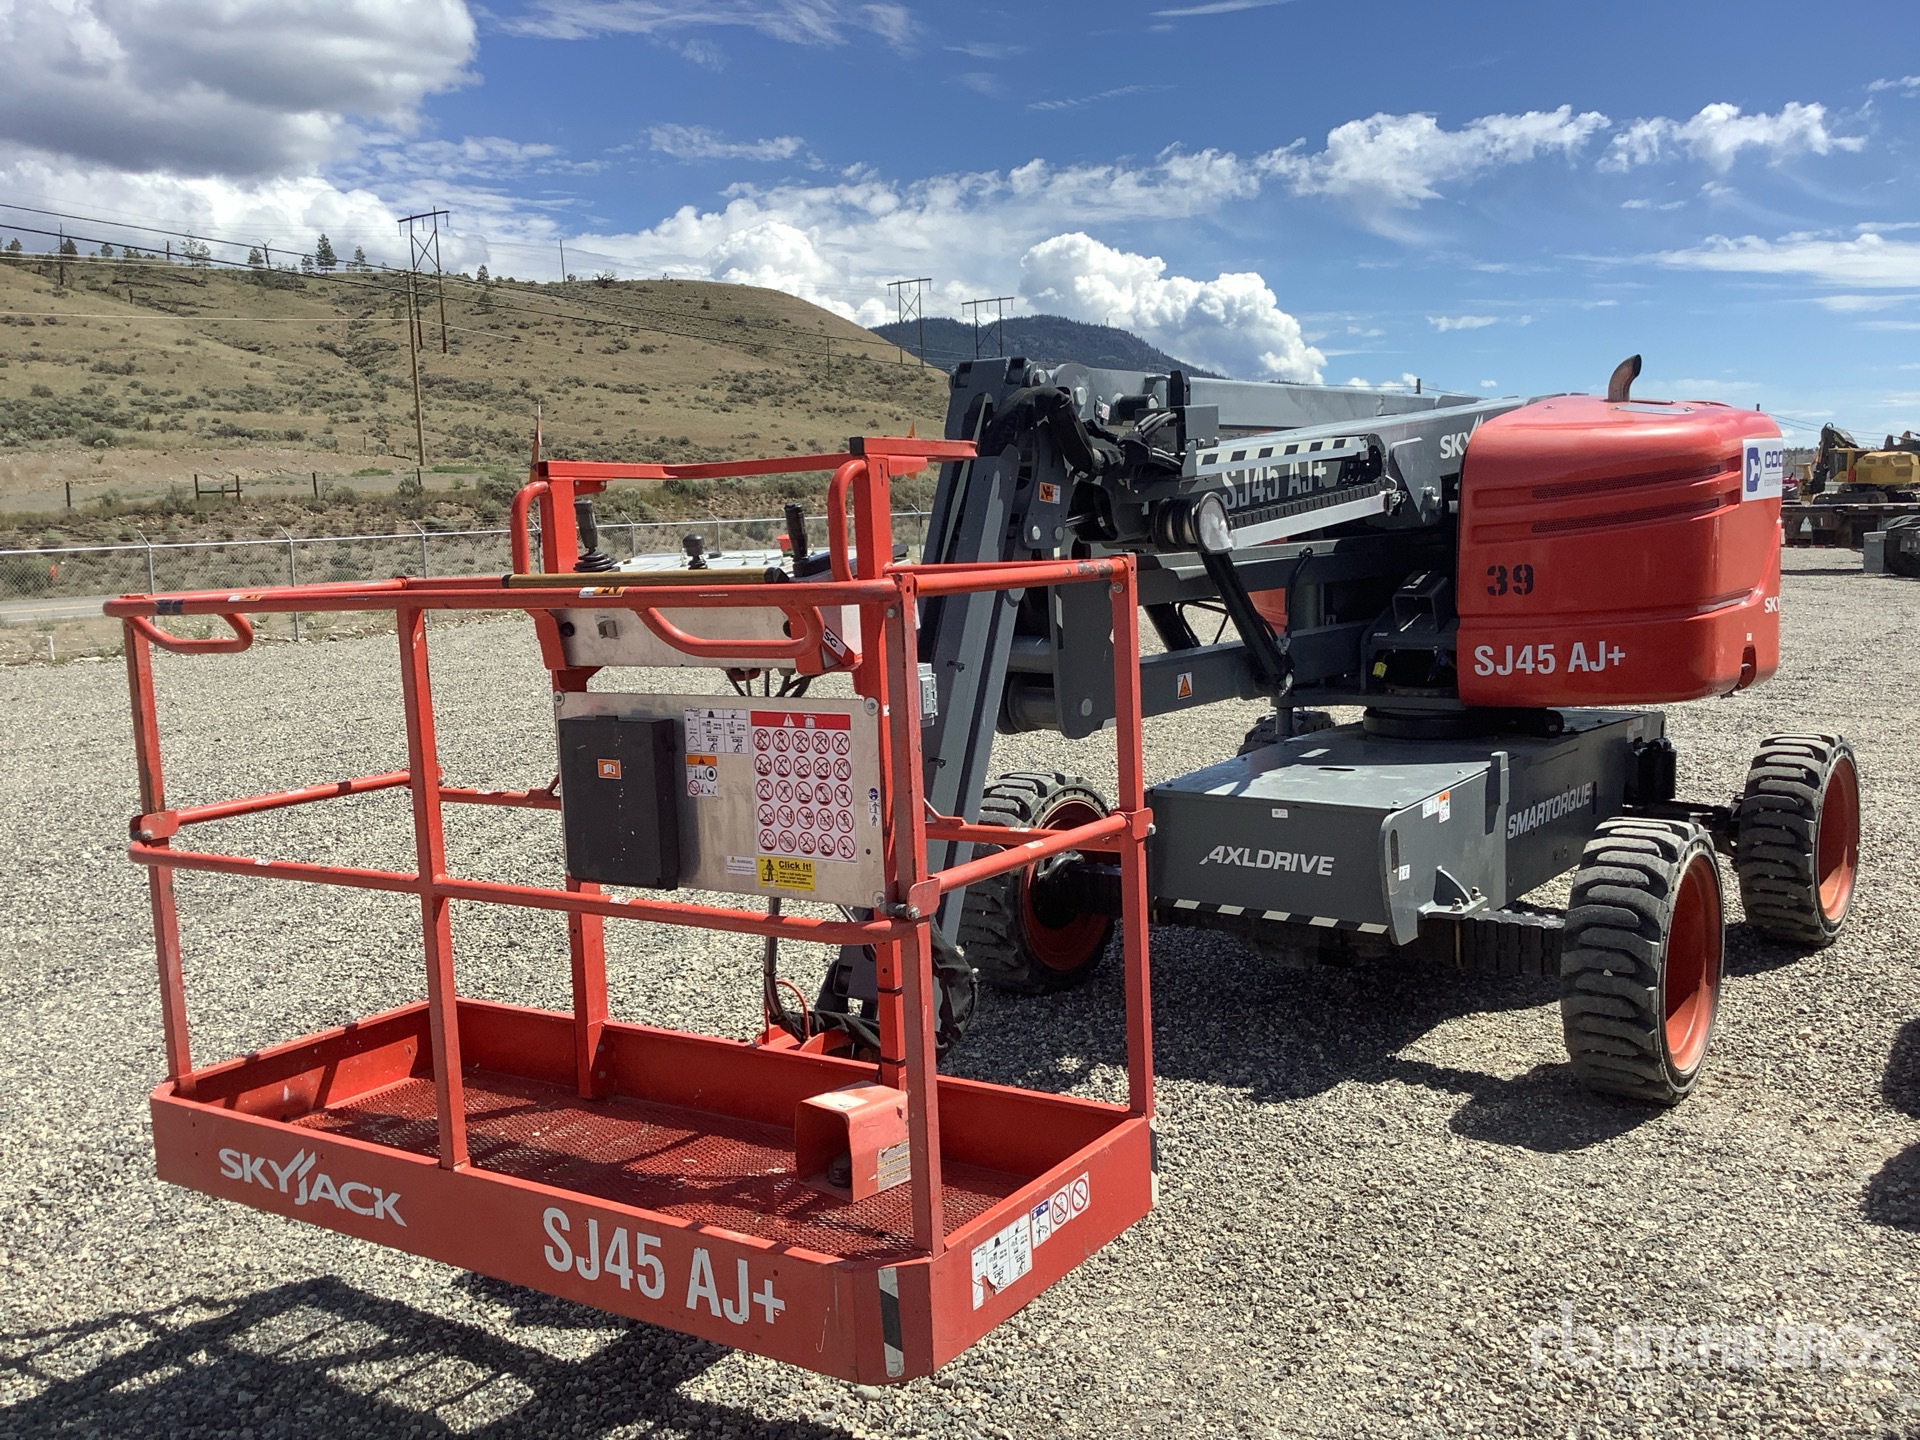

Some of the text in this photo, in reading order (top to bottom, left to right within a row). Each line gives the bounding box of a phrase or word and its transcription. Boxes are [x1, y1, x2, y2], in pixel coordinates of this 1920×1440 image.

[1222, 460, 1327, 510] SJ45 AJ+
[1487, 564, 1534, 596] 39
[1474, 641, 1626, 677] SJ45 AJ+
[778, 860, 812, 871] Click It!
[1200, 845, 1335, 877] AXLDRIVE
[219, 1147, 407, 1228] SKYJACK
[542, 1207, 786, 1326] SJ45 AJ+
